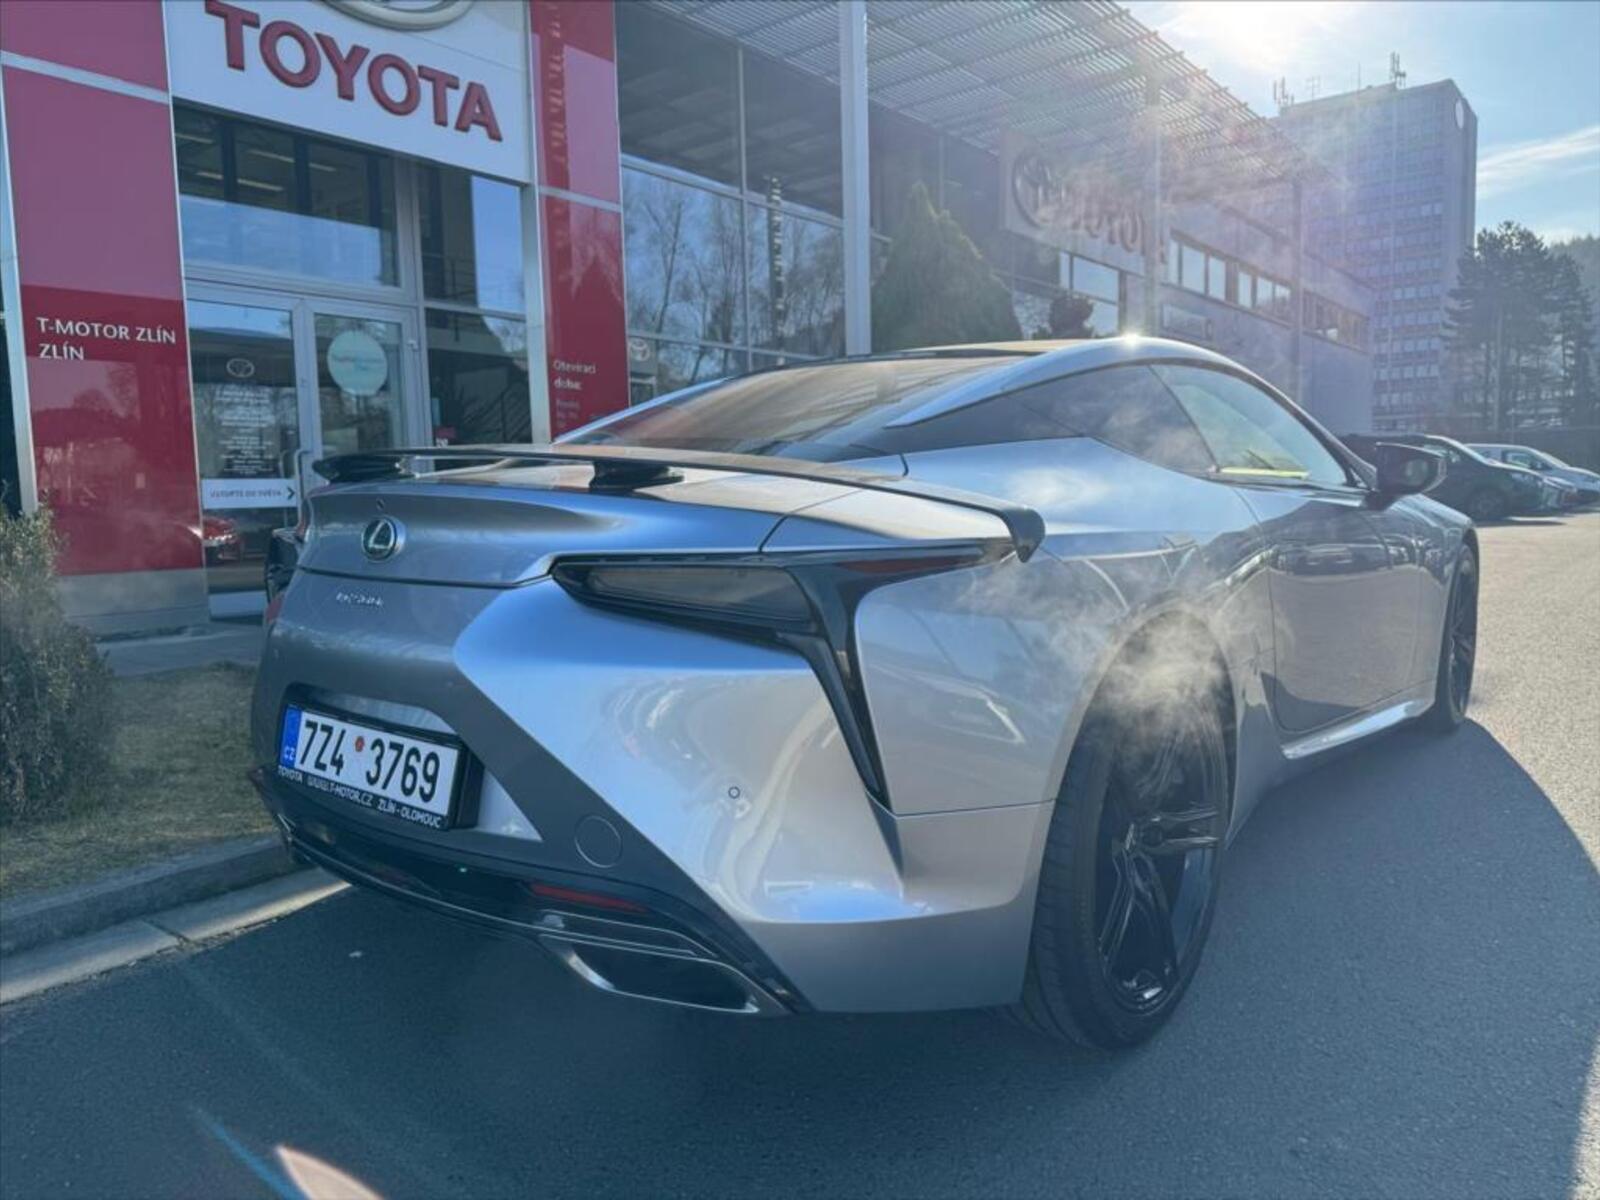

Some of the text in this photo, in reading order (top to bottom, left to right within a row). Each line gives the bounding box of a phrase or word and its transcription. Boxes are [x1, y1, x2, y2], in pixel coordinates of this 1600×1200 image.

[205, 0, 503, 143] TOYOTA
[36, 316, 177, 344] T-MOTOR ZLÍN
[38, 342, 85, 361] ZLÍN
[284, 746, 296, 760] CZ
[300, 719, 441, 804] 7Z4 3769
[278, 764, 304, 784] TOYOTA
[400, 804, 442, 829] OLOMOUC
